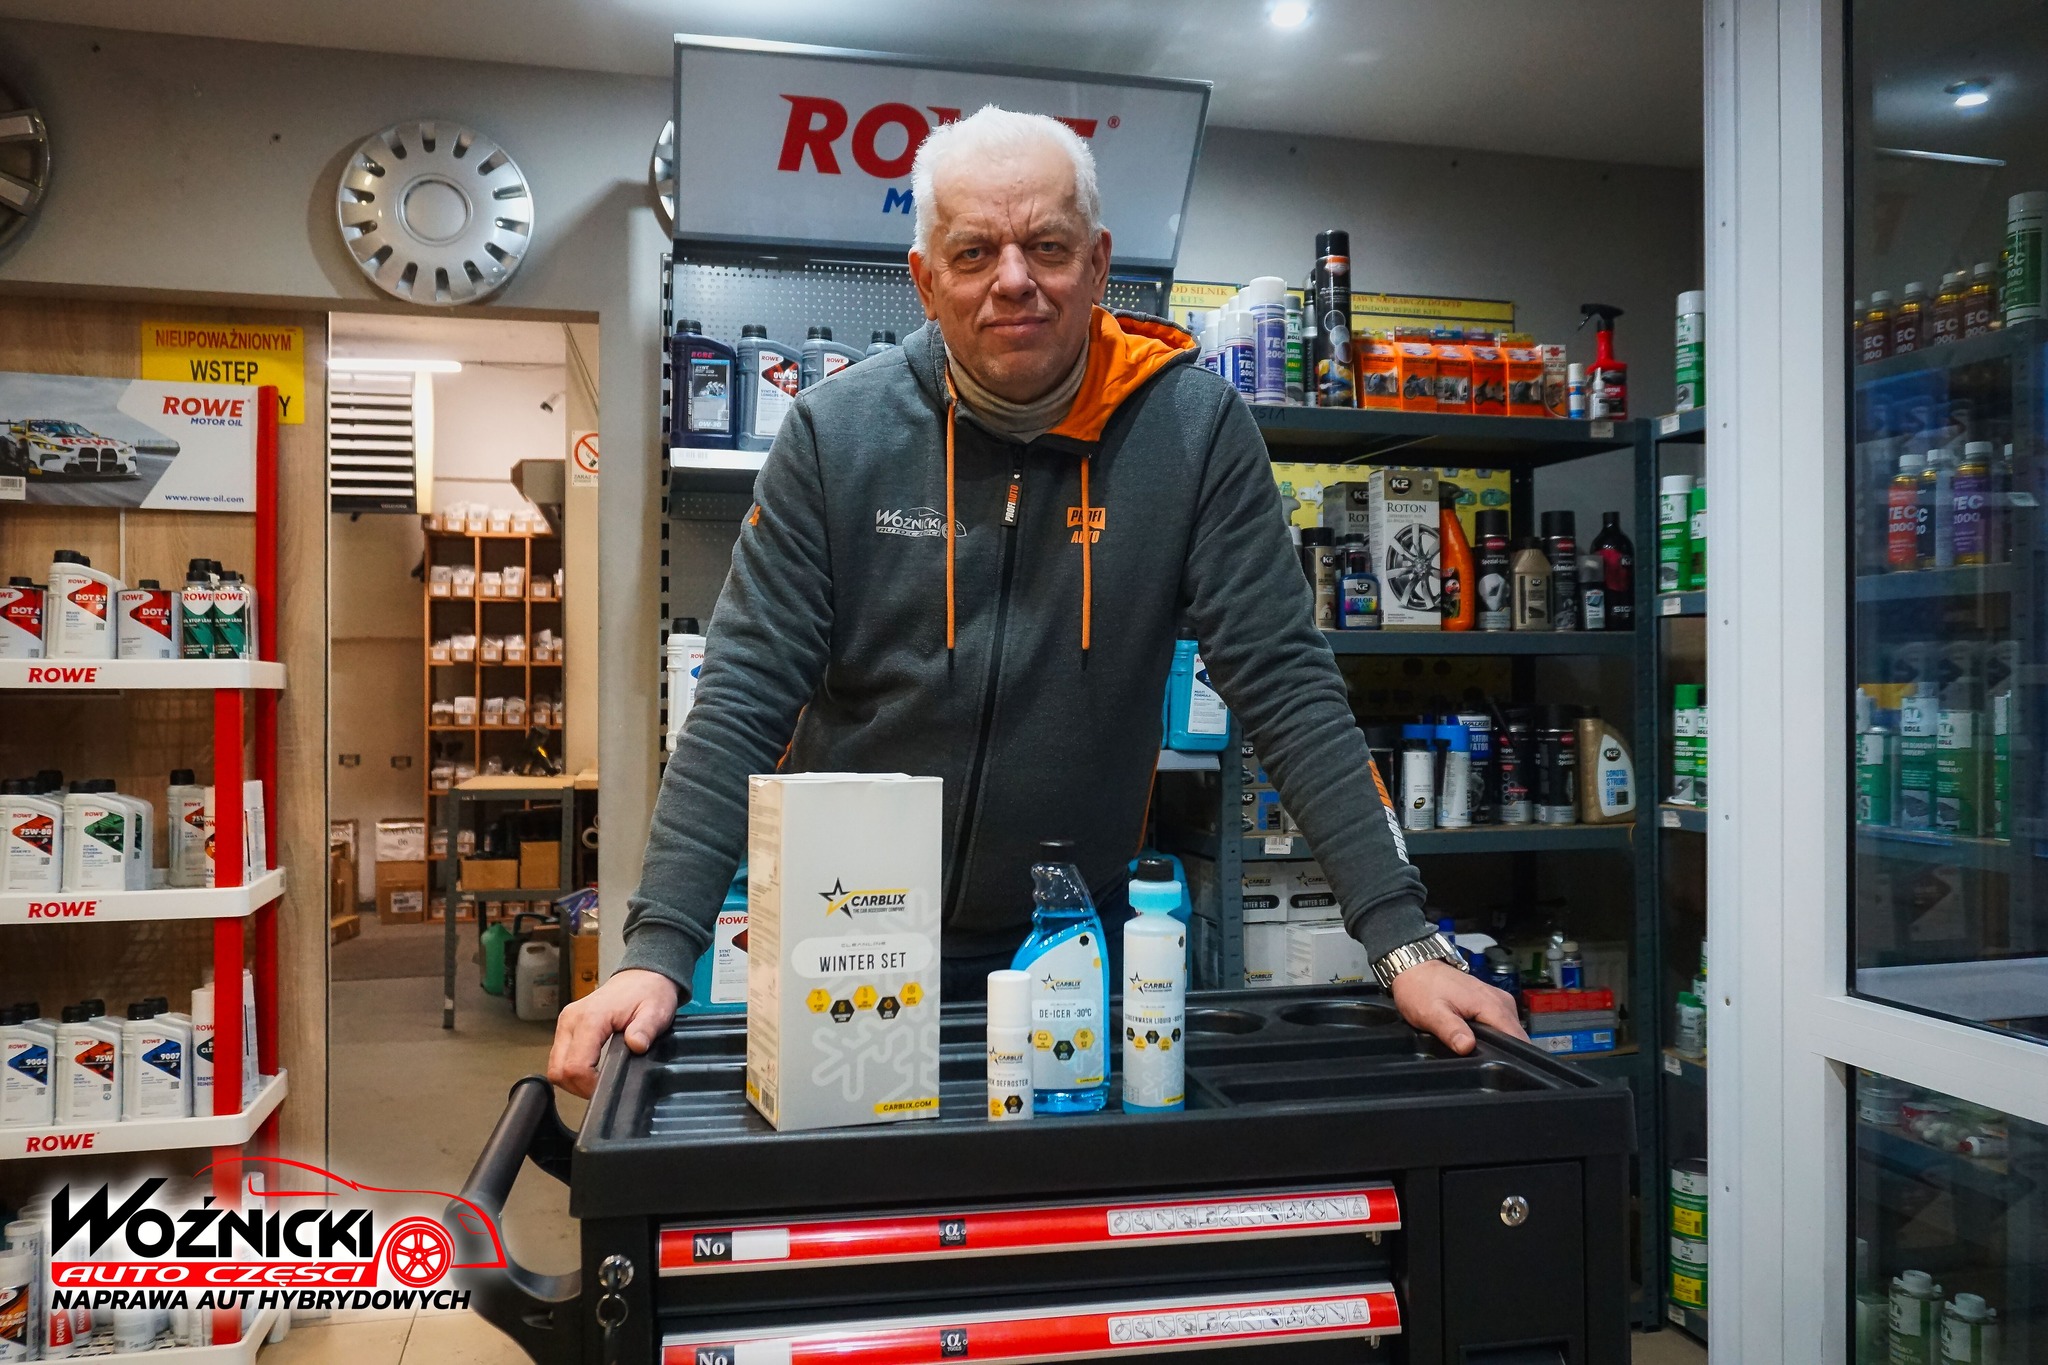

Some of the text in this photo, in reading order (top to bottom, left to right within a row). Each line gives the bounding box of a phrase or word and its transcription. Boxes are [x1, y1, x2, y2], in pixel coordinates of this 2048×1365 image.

[2007, 252, 2024, 268] EC
[1192, 286, 1227, 296] SILNIK
[1354, 304, 1391, 313] WINDOW
[1393, 306, 1421, 314] REPAIR
[1965, 310, 1988, 326] EC
[1933, 318, 1958, 333] EC
[156, 329, 291, 351] NIEUPOWAŻNIONYM
[1896, 328, 1915, 343] EC
[1864, 335, 1884, 350] EC
[190, 360, 258, 385] WSTĘP
[163, 396, 245, 418] ROWE
[190, 418, 243, 427] MOTOR OIL
[1391, 479, 1409, 488] K2
[165, 494, 245, 503] www.rowe-oil.com
[1387, 502, 1427, 513] ROTON
[1349, 512, 1369, 523] ROT
[1323, 556, 1333, 564] K2
[11, 606, 33, 614] DOT
[28, 667, 97, 683] ROWE
[1606, 778, 1628, 787] STRONG
[851, 894, 906, 907] CARBLIX
[28, 901, 97, 918] ROWE
[719, 916, 748, 925] ROWE
[819, 952, 907, 972] WINTER SET
[1039, 1008, 1071, 1018] DE-ICER
[998, 1053, 1023, 1061] CARBLIX
[996, 1078, 1028, 1087] DEFROSTER
[883, 1101, 932, 1111] CARBLIX.COM
[26, 1134, 95, 1152] ROWE
[694, 1238, 726, 1257] No
[56, 1317, 65, 1343] ROWE
